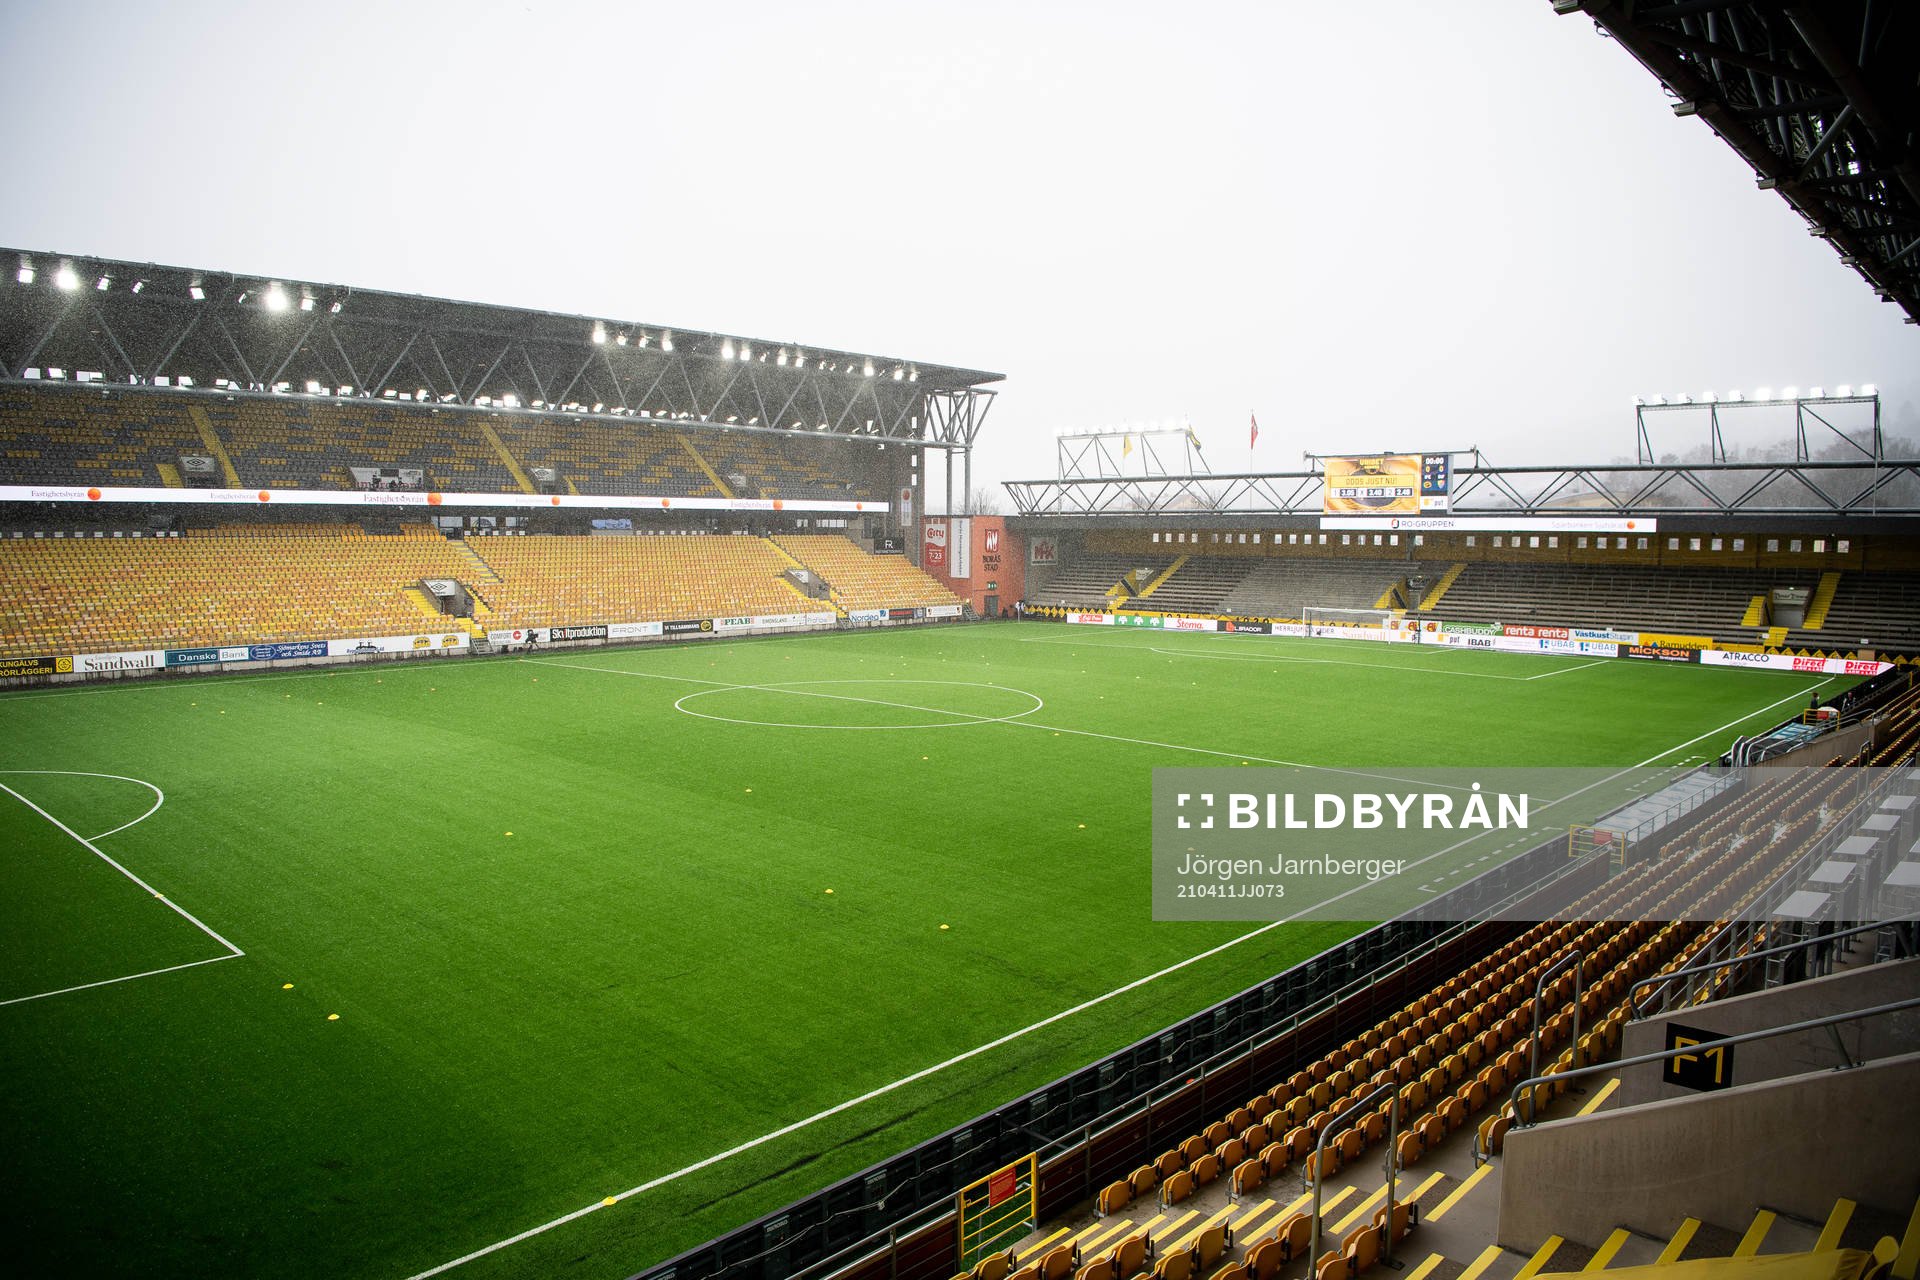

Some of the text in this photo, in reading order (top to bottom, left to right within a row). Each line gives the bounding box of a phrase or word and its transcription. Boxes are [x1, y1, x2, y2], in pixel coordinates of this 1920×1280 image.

[1401, 520, 1454, 528] RO-GRUPPEN
[724, 617, 750, 626] PEAB
[1505, 624, 1568, 639] renta renta
[178, 652, 217, 662] Danske
[222, 651, 245, 660] Bank
[1722, 652, 1770, 663] ATRACCO
[84, 654, 156, 672] Sandwall
[1673, 1036, 1724, 1084] F1
